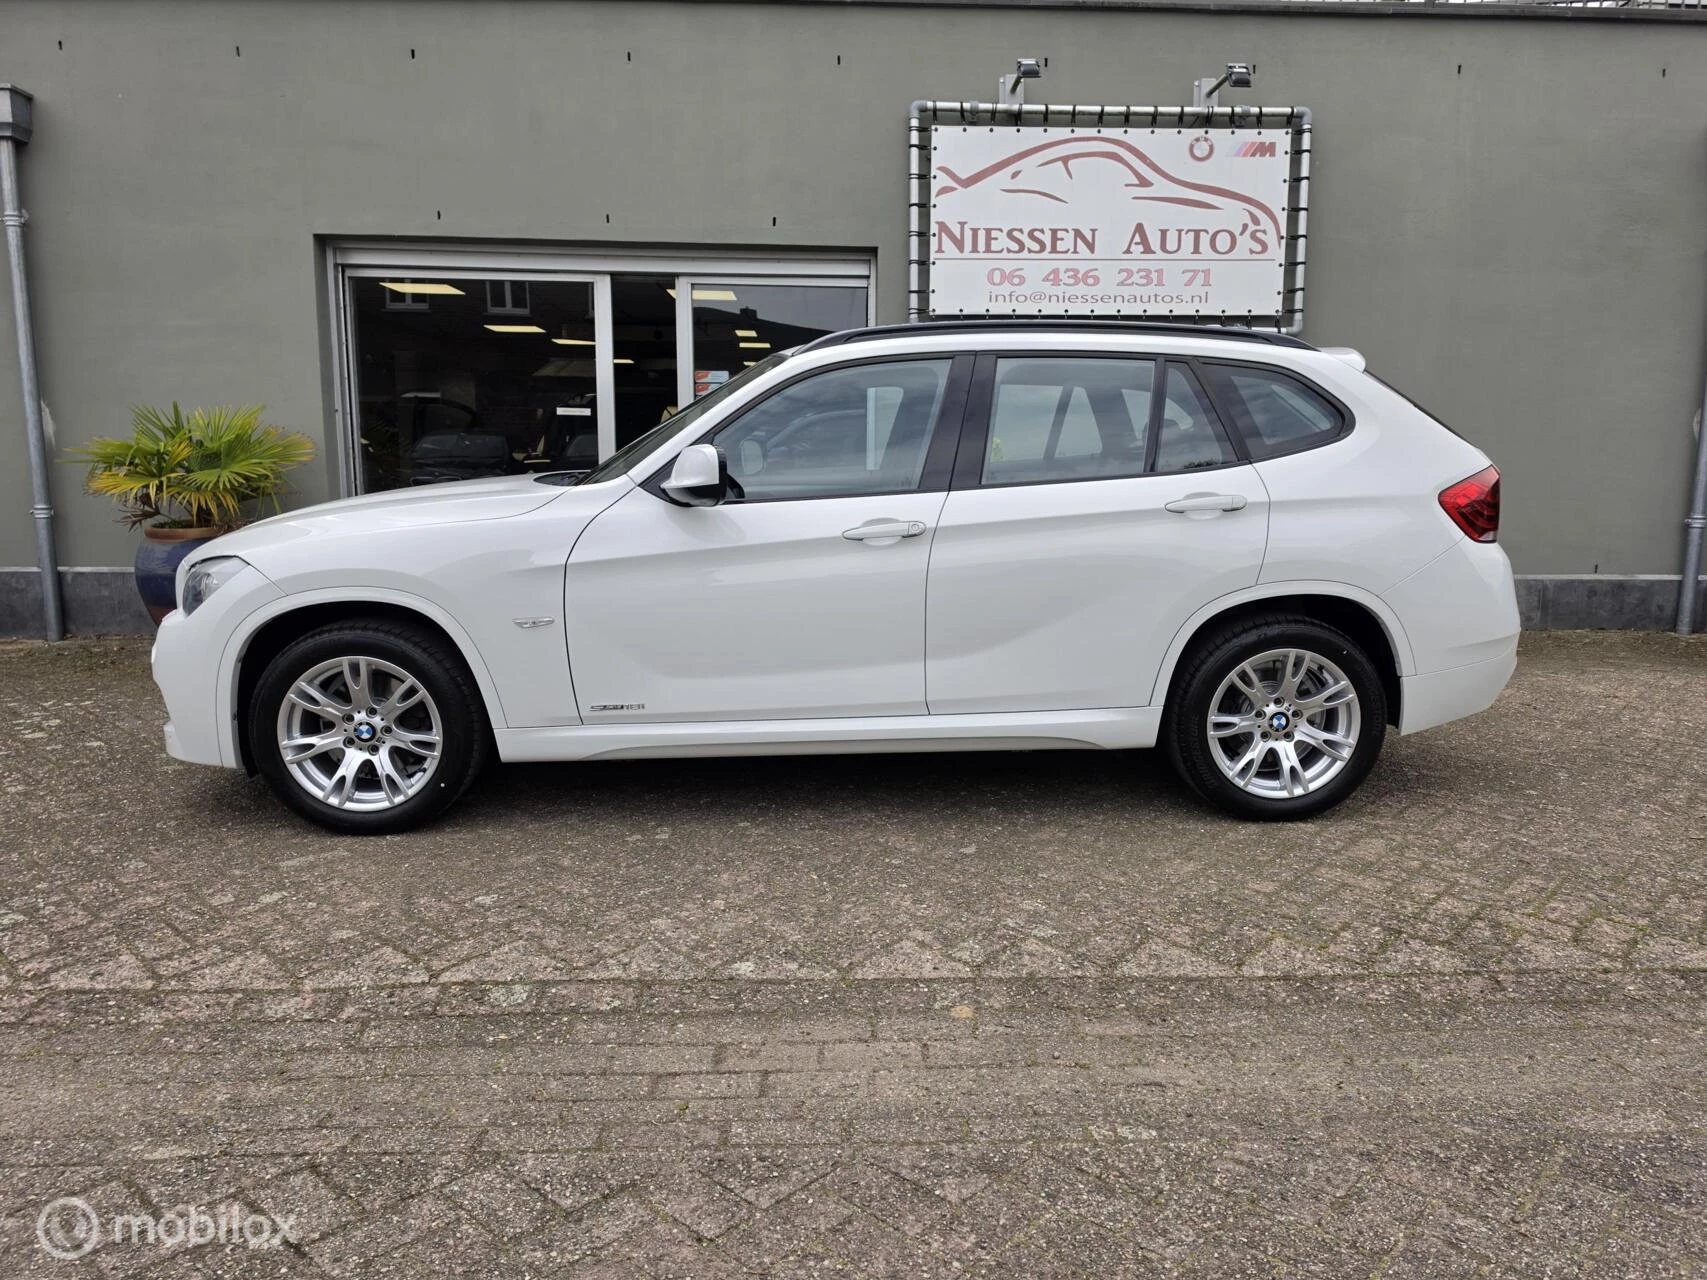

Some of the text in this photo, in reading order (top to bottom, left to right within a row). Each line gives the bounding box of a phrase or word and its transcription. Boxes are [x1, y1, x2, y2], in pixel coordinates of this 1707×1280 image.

[934, 220, 1099, 255] NIESSEN
[986, 267, 1213, 288] 06 436 231 71
[988, 290, 1210, 305] info@niessenautos.nl
